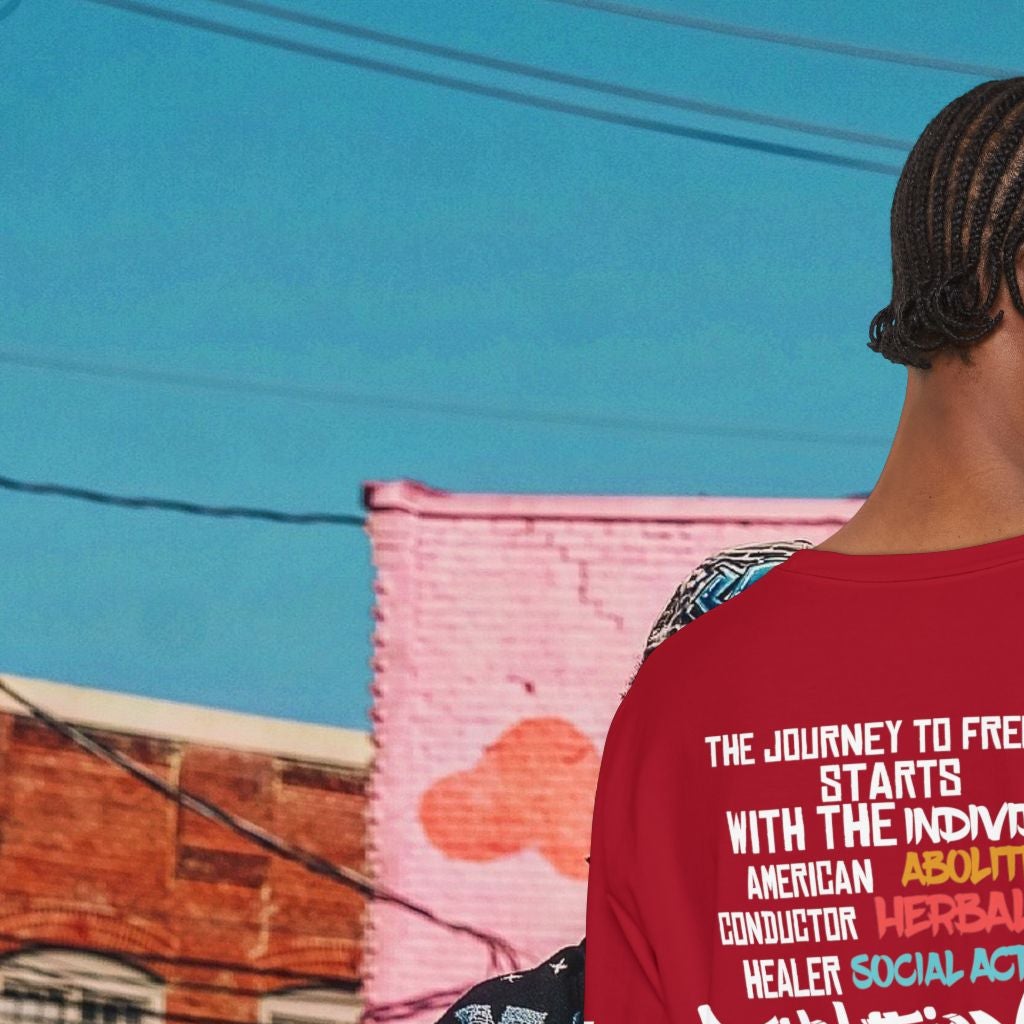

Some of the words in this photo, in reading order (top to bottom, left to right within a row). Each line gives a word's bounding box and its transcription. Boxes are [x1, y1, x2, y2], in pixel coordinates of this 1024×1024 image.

[705, 732, 755, 767] THE
[764, 720, 902, 759] JOURNEY
[913, 718, 951, 753] TO
[820, 758, 961, 802] STARTS
[726, 807, 805, 854] WITH
[816, 802, 897, 850] THE
[748, 859, 873, 900] AMERICAN
[718, 906, 858, 946] CONDUCTOR
[743, 956, 843, 999] HEALER
[851, 950, 964, 989] SOCIAL
